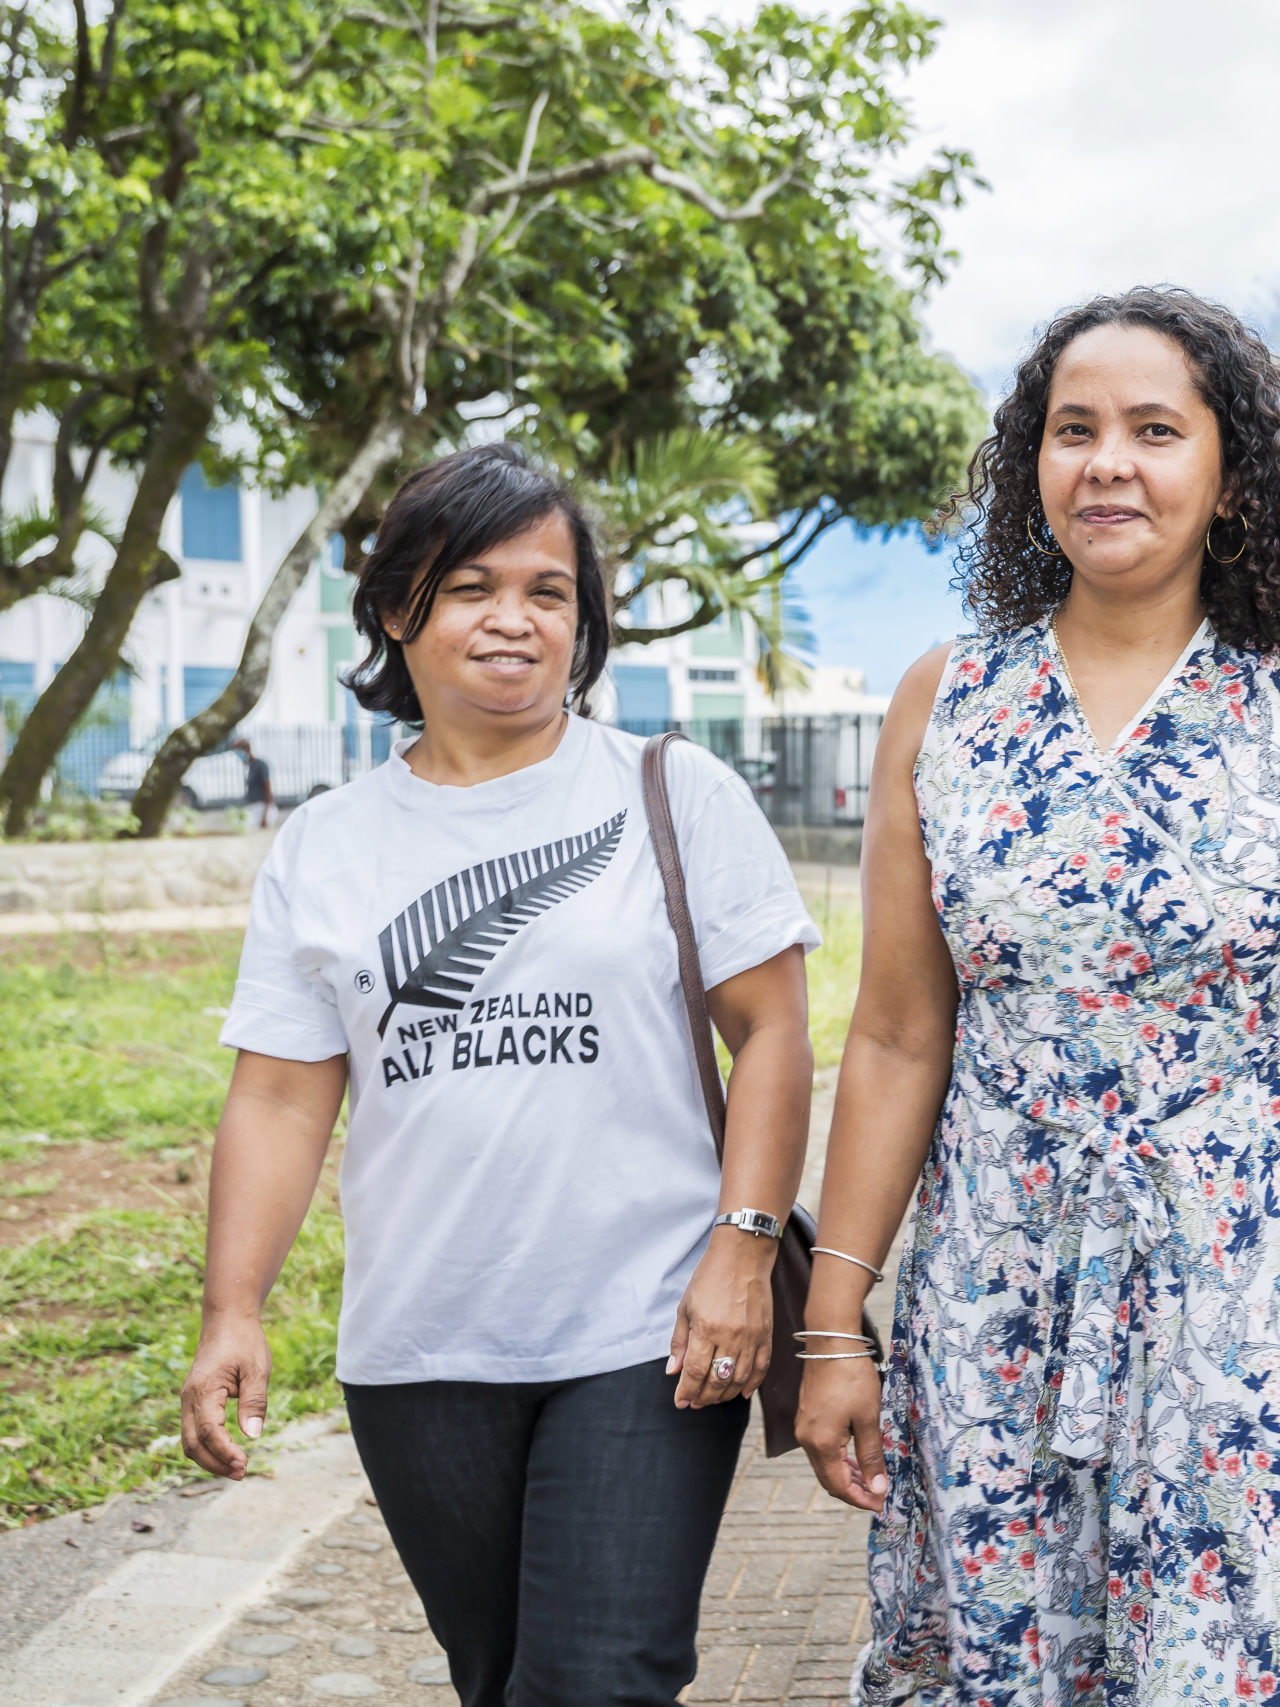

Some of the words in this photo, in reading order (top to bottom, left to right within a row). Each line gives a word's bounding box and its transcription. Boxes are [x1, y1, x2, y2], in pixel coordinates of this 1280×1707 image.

[397, 1014, 458, 1045] NEW
[470, 992, 593, 1025] ZEALAND
[381, 1041, 434, 1088] ALL
[452, 1025, 600, 1071] BLACKS
